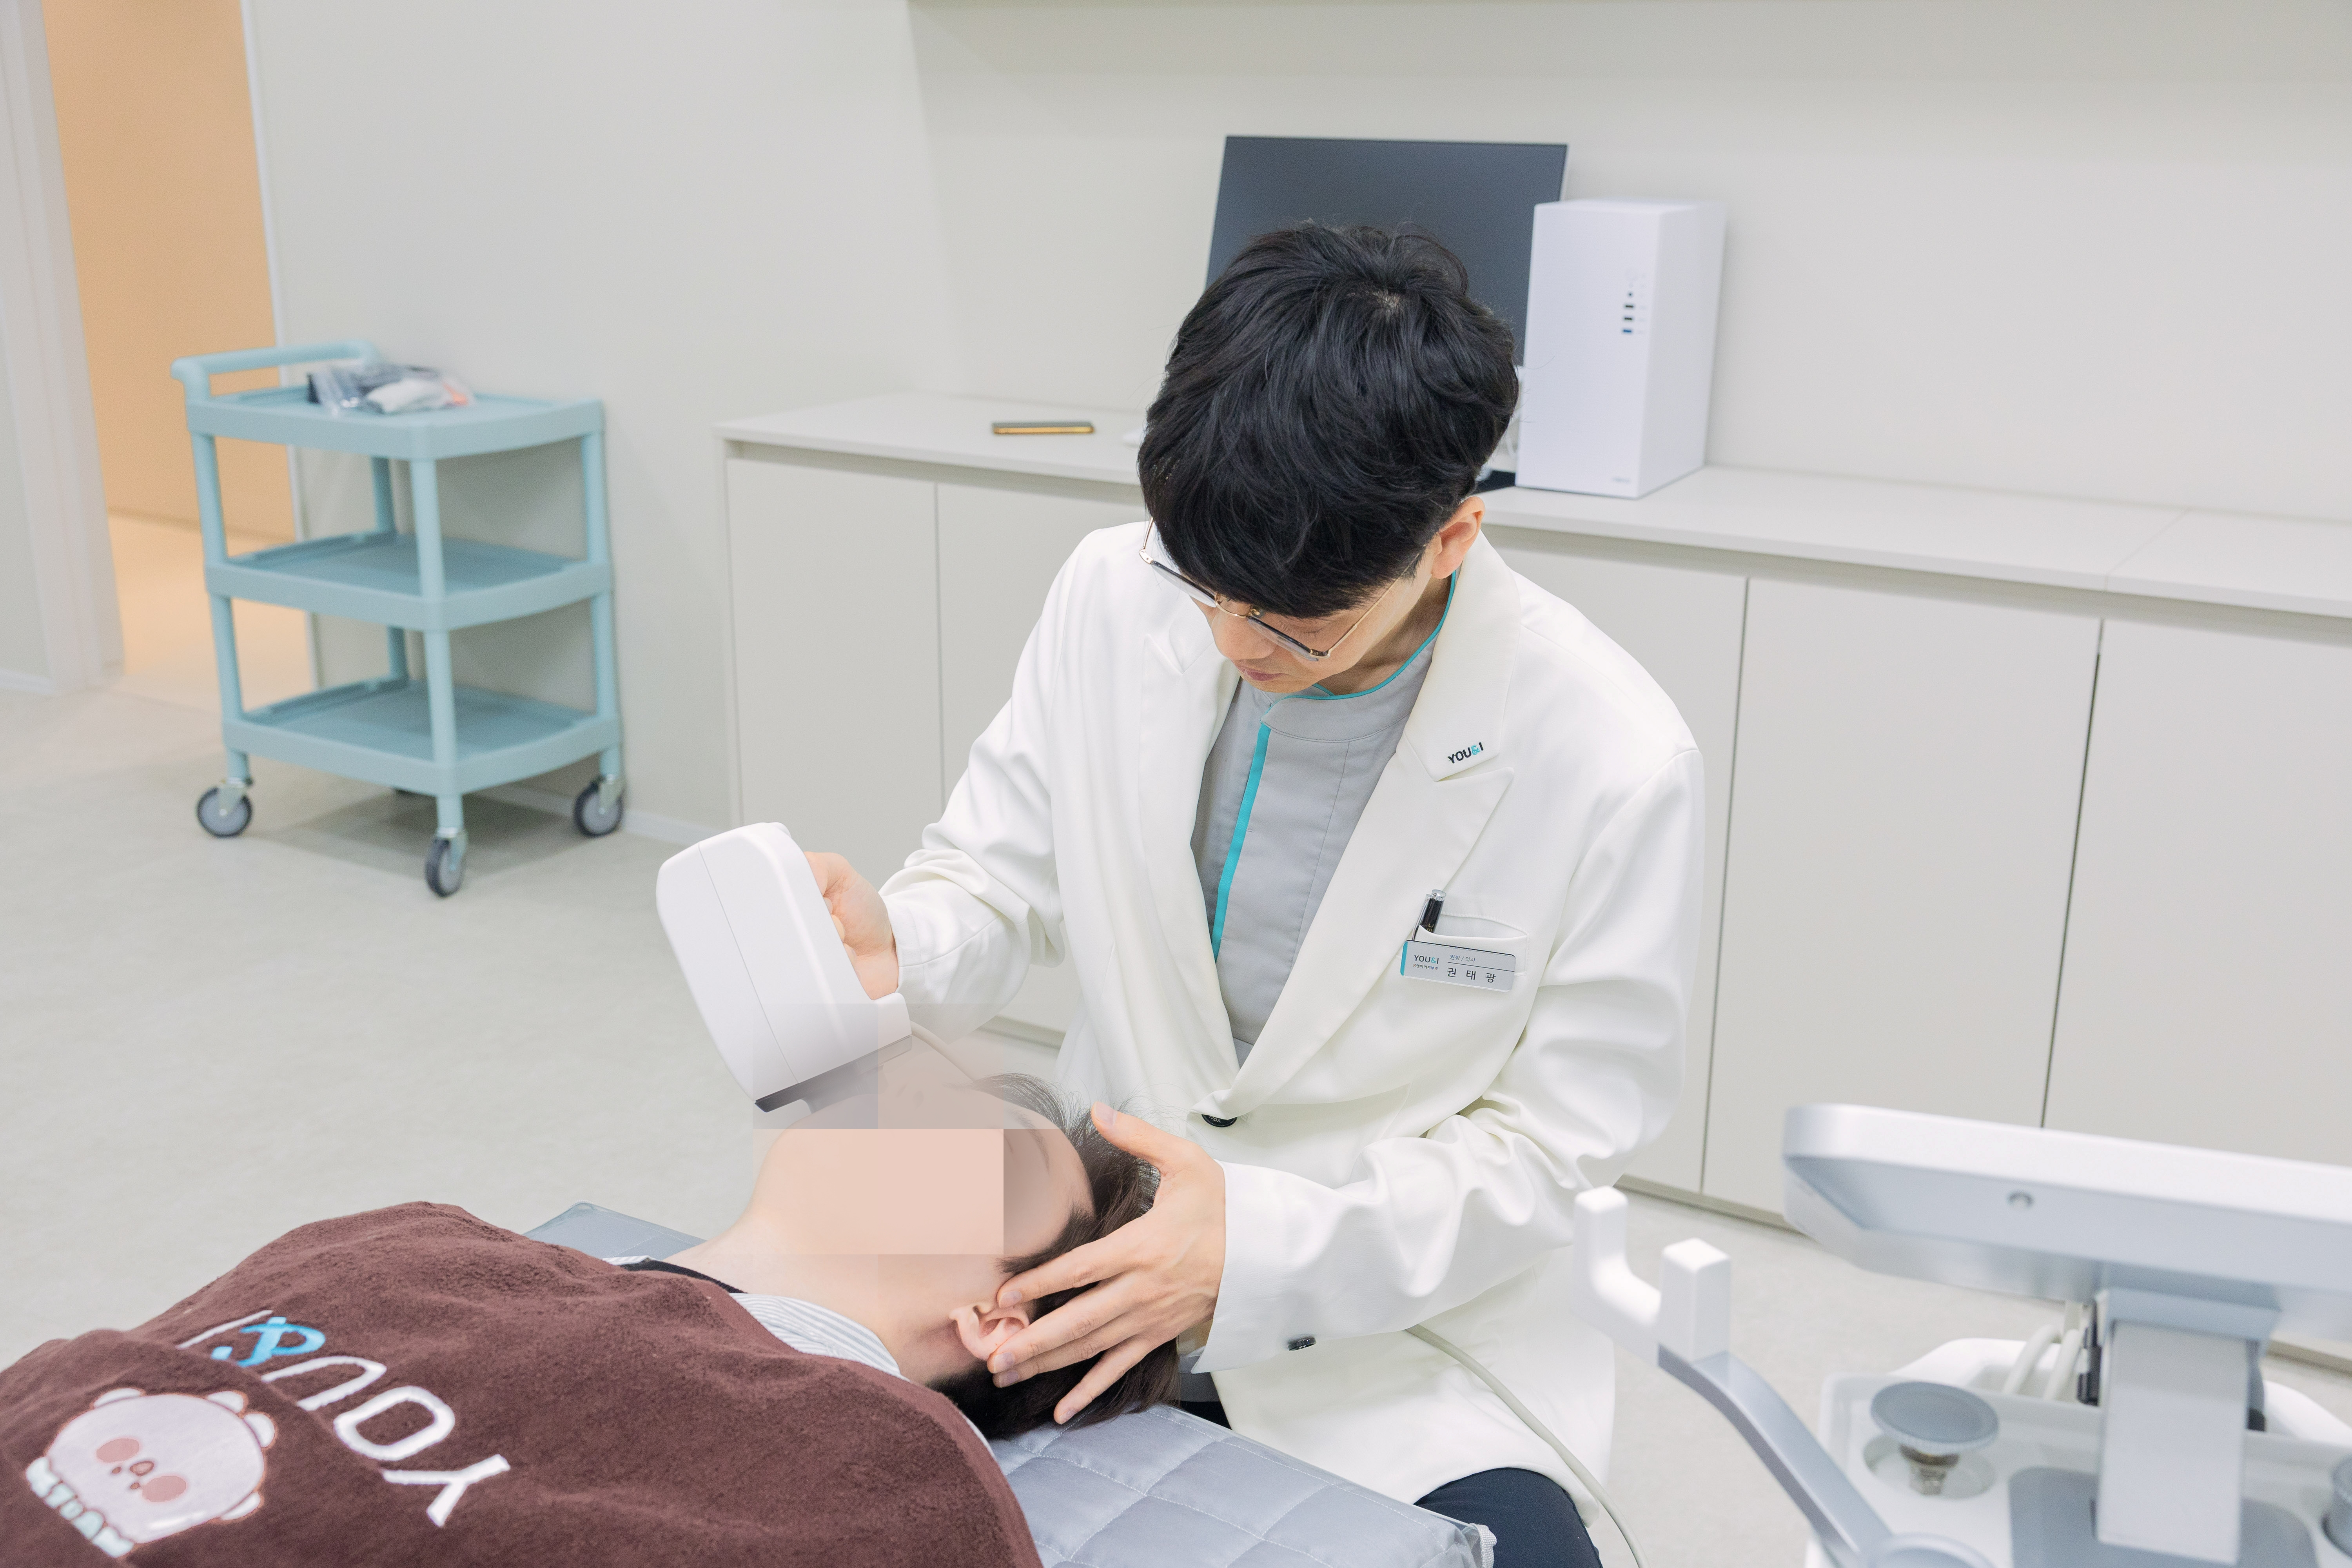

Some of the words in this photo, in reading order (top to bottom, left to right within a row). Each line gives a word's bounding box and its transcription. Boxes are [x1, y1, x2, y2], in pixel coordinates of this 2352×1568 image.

[1447, 742, 1484, 764] YOU&I
[1414, 955, 1439, 964] YOU&I
[176, 1310, 510, 1527] YOU&I
